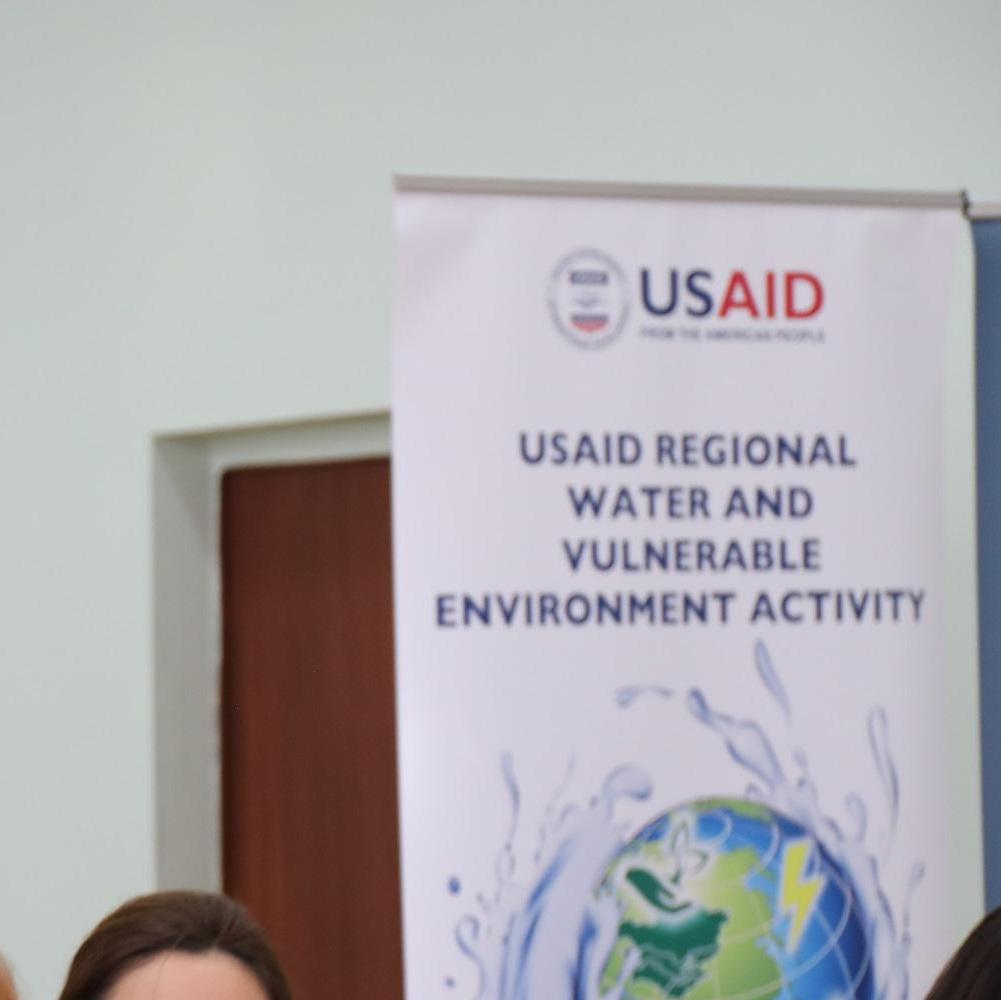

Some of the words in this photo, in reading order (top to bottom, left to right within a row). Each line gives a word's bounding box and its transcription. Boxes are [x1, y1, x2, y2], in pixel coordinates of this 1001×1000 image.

[640, 268, 824, 320] USAID
[520, 432, 642, 466] USAID
[656, 433, 856, 467] REGIONAL
[568, 486, 710, 519] WATER
[724, 487, 813, 519] AND
[562, 538, 820, 572] VULNERABLE
[436, 592, 736, 627] ENVIRONMENT
[750, 589, 925, 623] ACTIVITY
